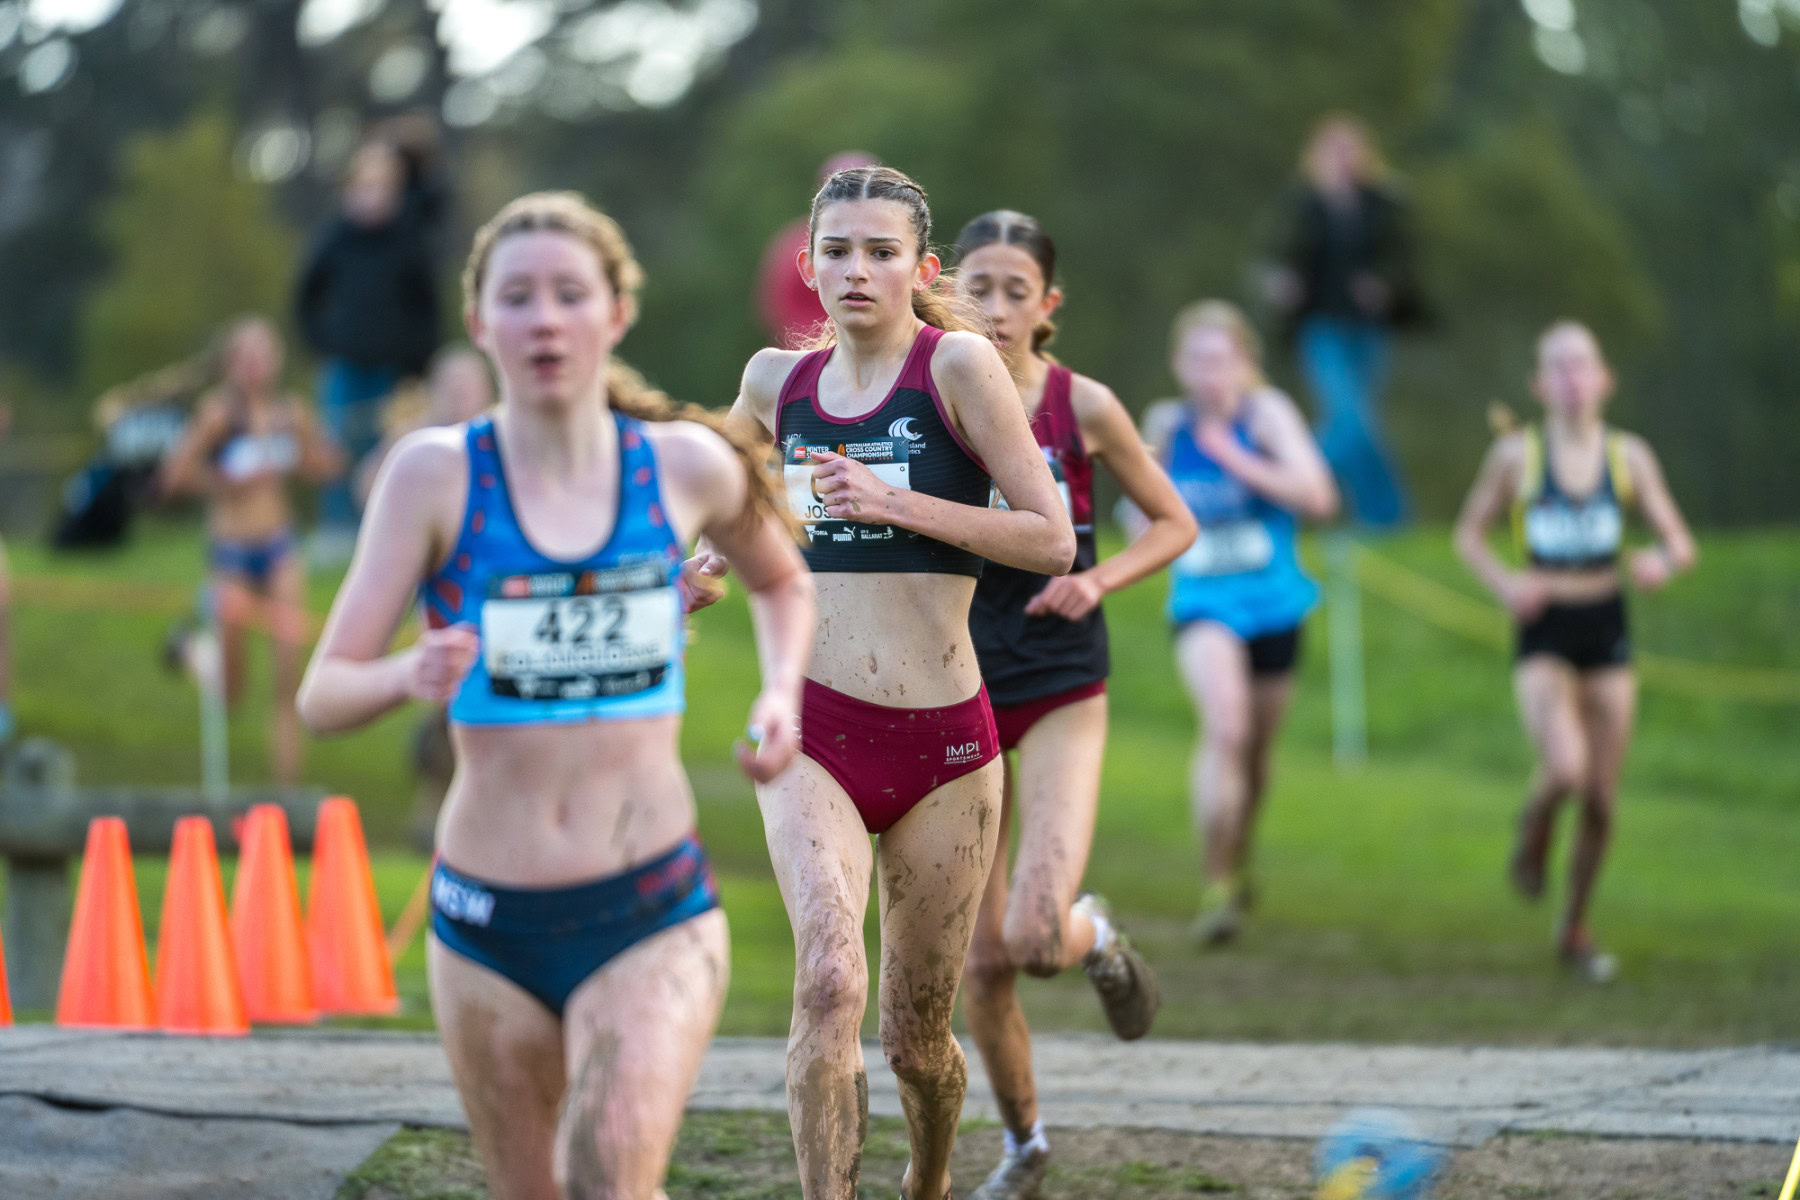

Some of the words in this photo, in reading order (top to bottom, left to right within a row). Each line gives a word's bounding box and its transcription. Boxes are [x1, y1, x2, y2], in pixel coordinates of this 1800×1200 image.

[806, 446, 829, 454] WINTER
[846, 451, 893, 459] CHAMPIONSHIPS
[805, 505, 832, 519] JOS
[832, 533, 852, 542] PUMA
[533, 596, 628, 644] 422
[946, 741, 978, 757] IMPI
[946, 753, 979, 762] SPORTSWEAR
